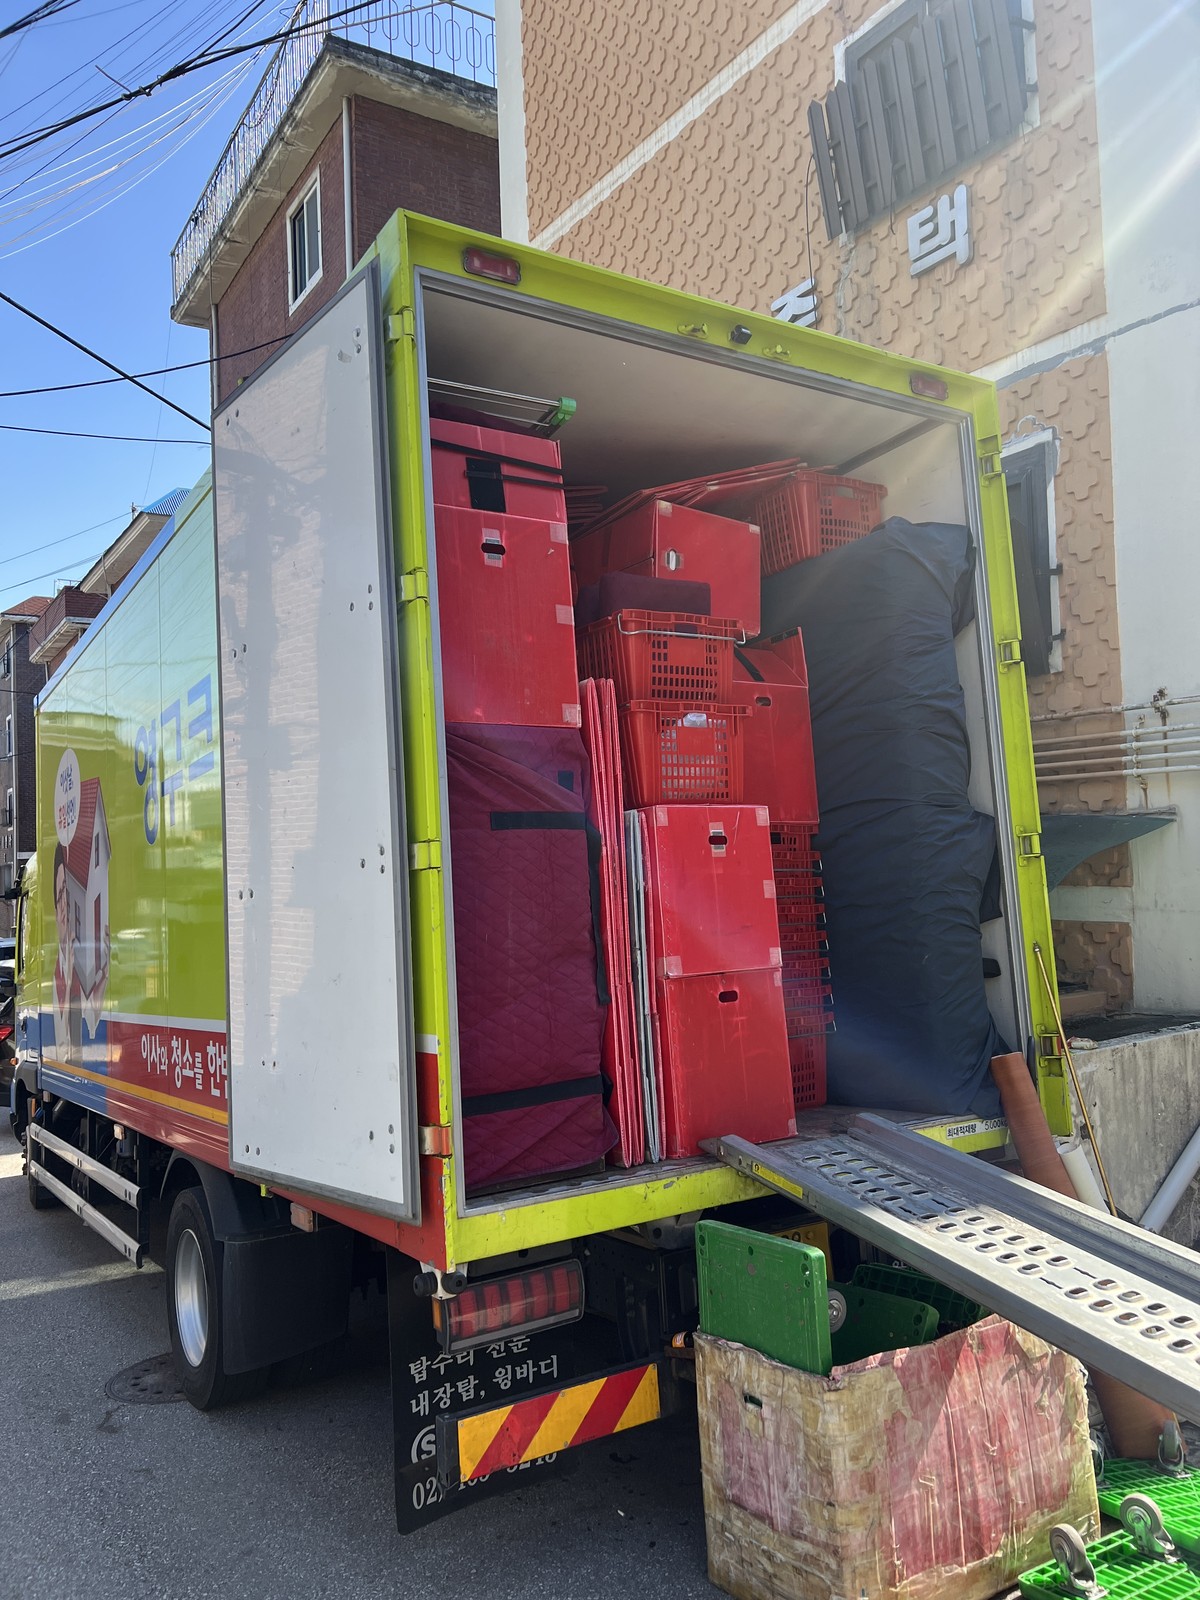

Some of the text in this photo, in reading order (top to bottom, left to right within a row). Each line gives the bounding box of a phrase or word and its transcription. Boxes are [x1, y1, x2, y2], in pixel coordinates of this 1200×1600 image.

[141, 1033, 169, 1077] 이사와
[171, 1035, 204, 1091] 청소를
[947, 1123, 977, 1137] 최대적재량
[410, 1354, 558, 1417] 내장탑, 윙바디
